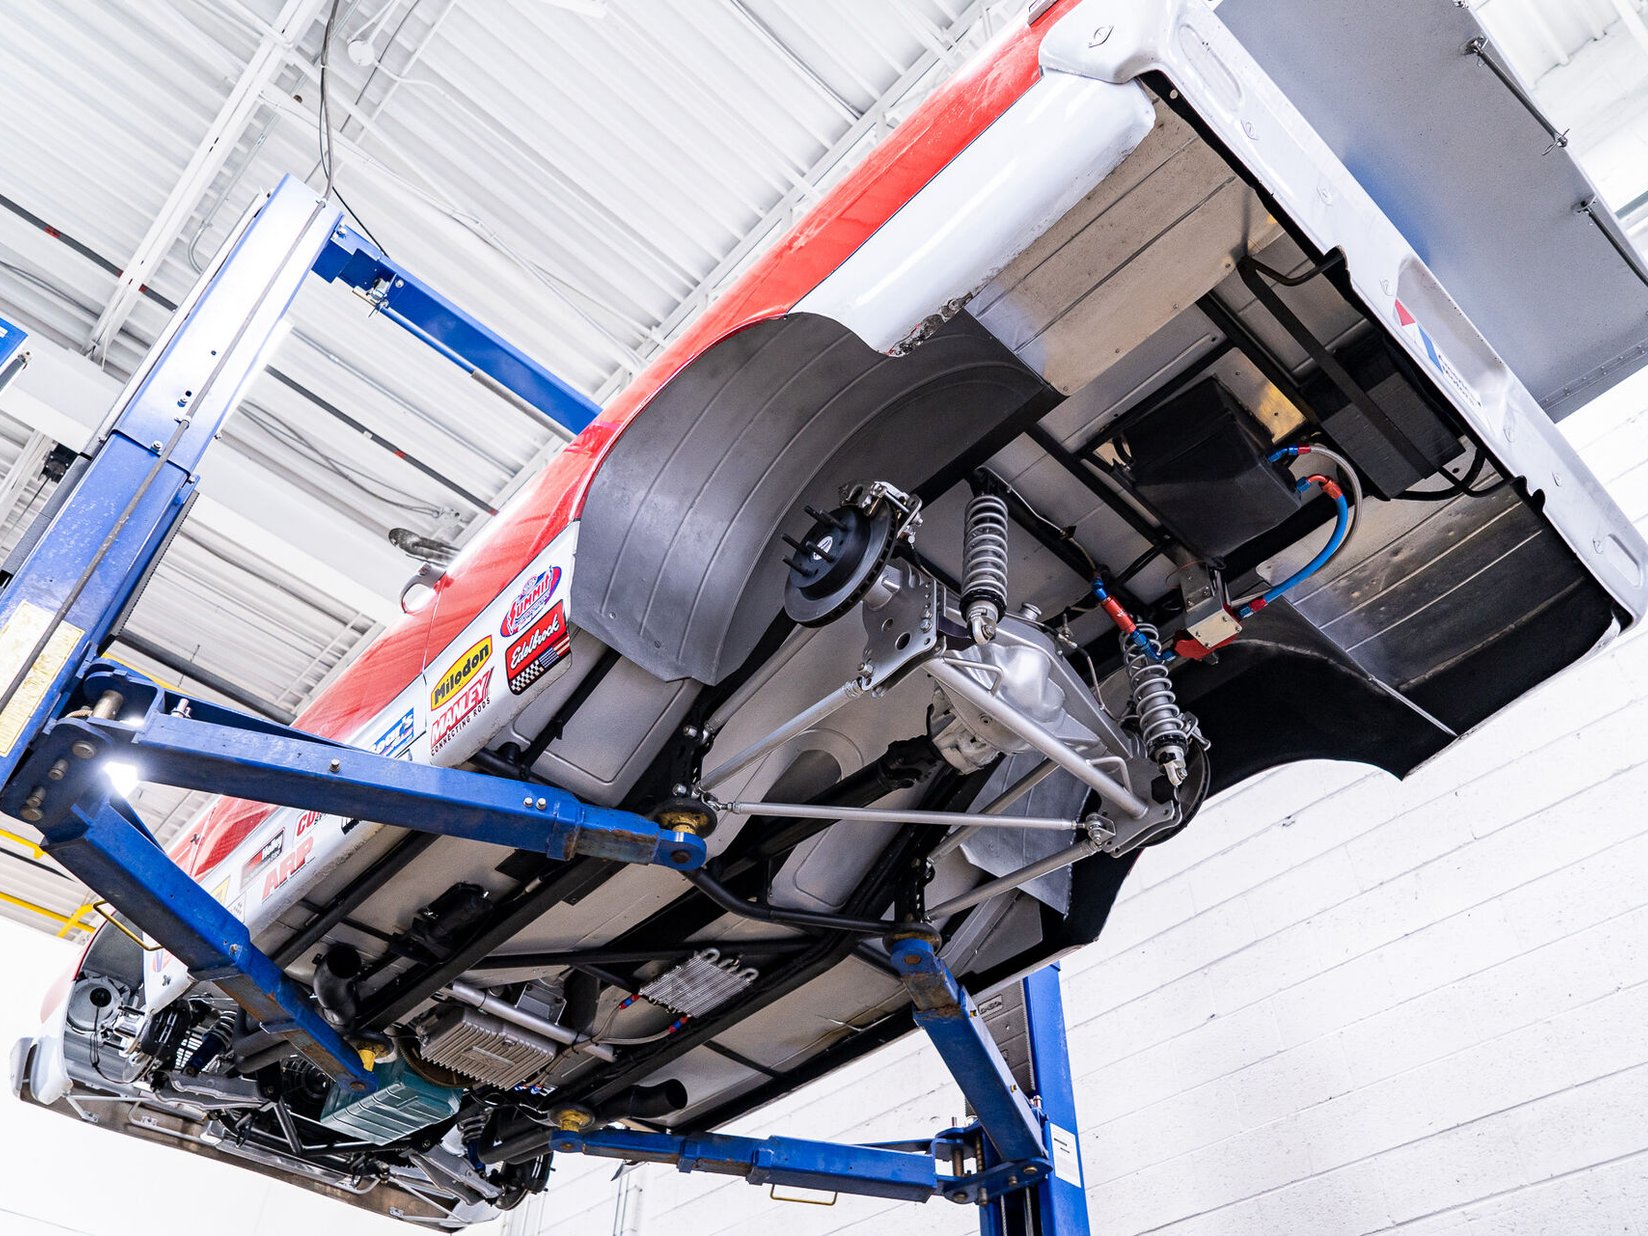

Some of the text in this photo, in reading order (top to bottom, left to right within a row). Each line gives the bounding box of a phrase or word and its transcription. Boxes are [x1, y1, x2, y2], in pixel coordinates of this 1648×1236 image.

[509, 573, 550, 627] SUMMIT
[510, 613, 559, 669] Edelbrock
[434, 645, 488, 705] Milodon
[431, 668, 491, 748] MANLEY
[431, 715, 470, 756] CONNECTING
[473, 696, 491, 717] RODS
[263, 838, 313, 898] ARP
